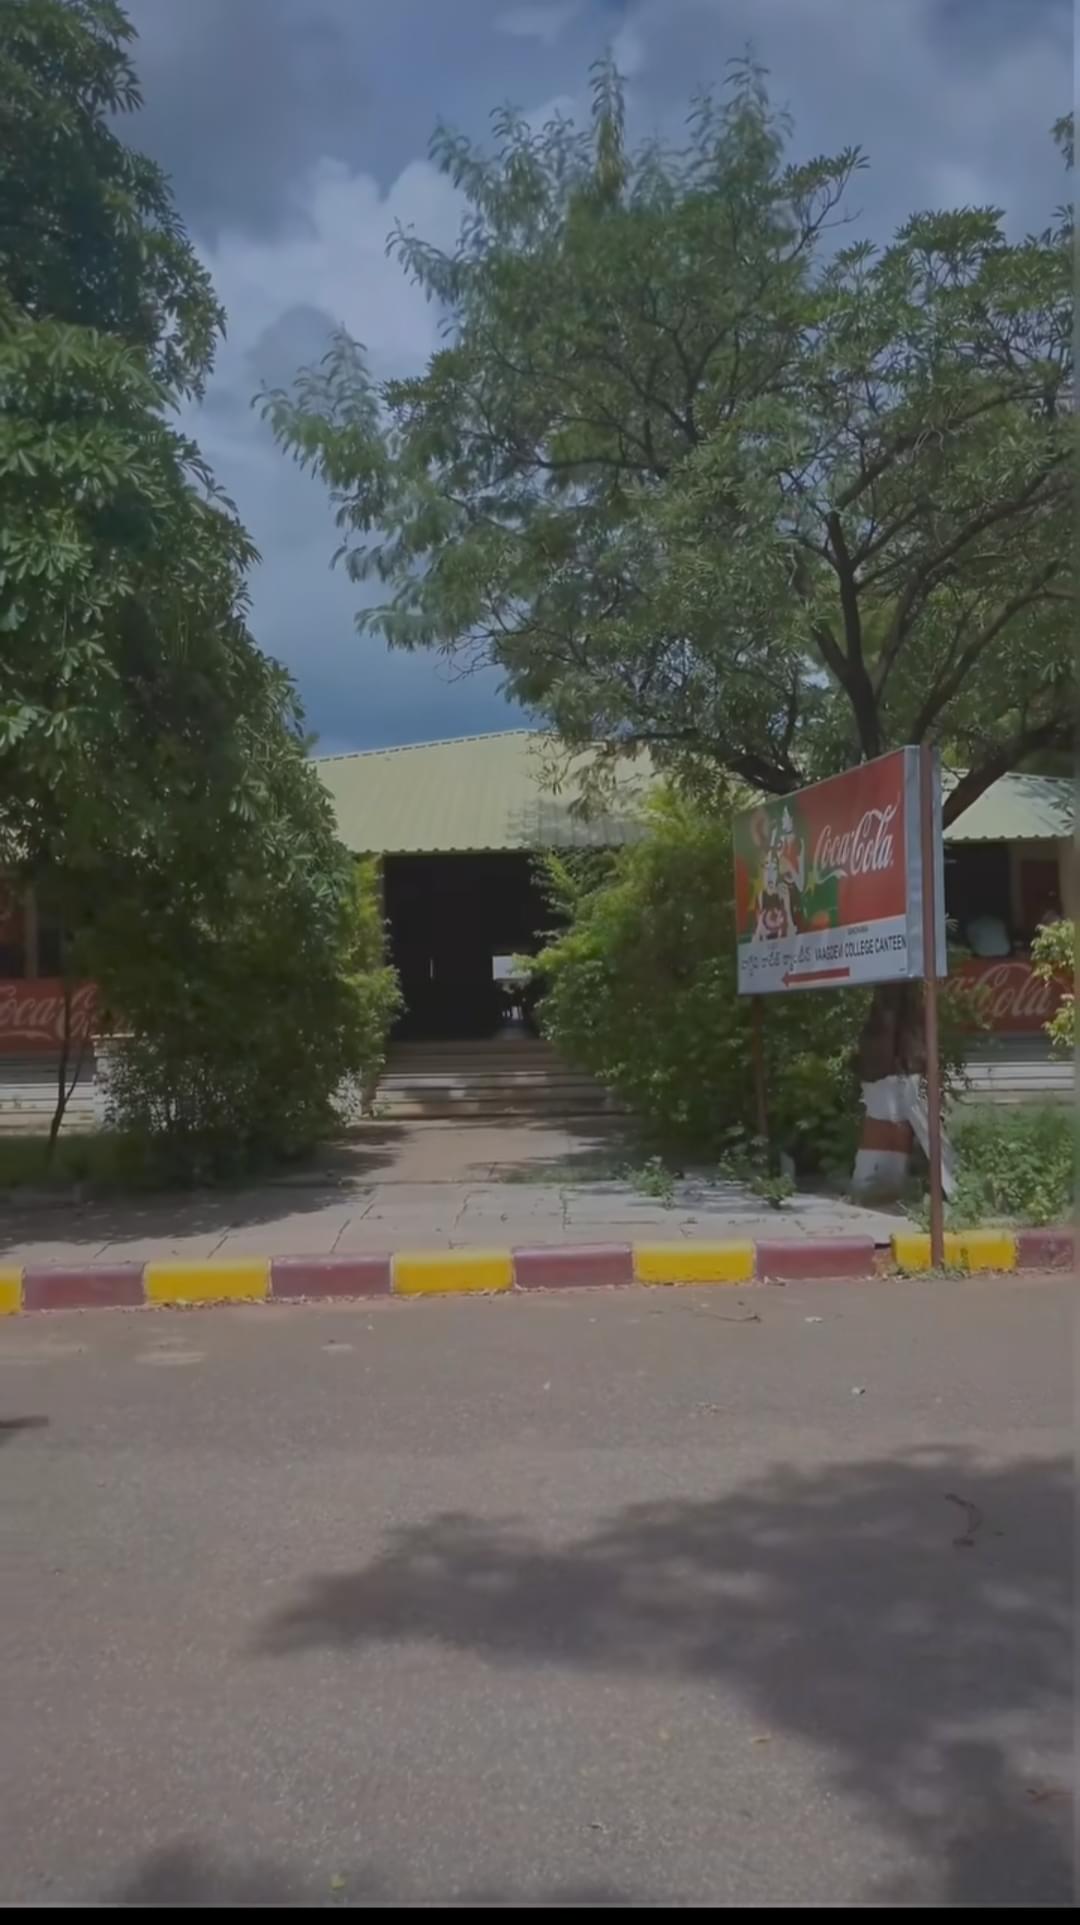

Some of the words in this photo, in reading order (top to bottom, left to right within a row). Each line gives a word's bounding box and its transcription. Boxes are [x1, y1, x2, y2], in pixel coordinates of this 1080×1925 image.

[813, 800, 899, 884] Coca-Cola
[845, 939, 874, 958] COLLEGE
[875, 934, 907, 954] CANTEEN
